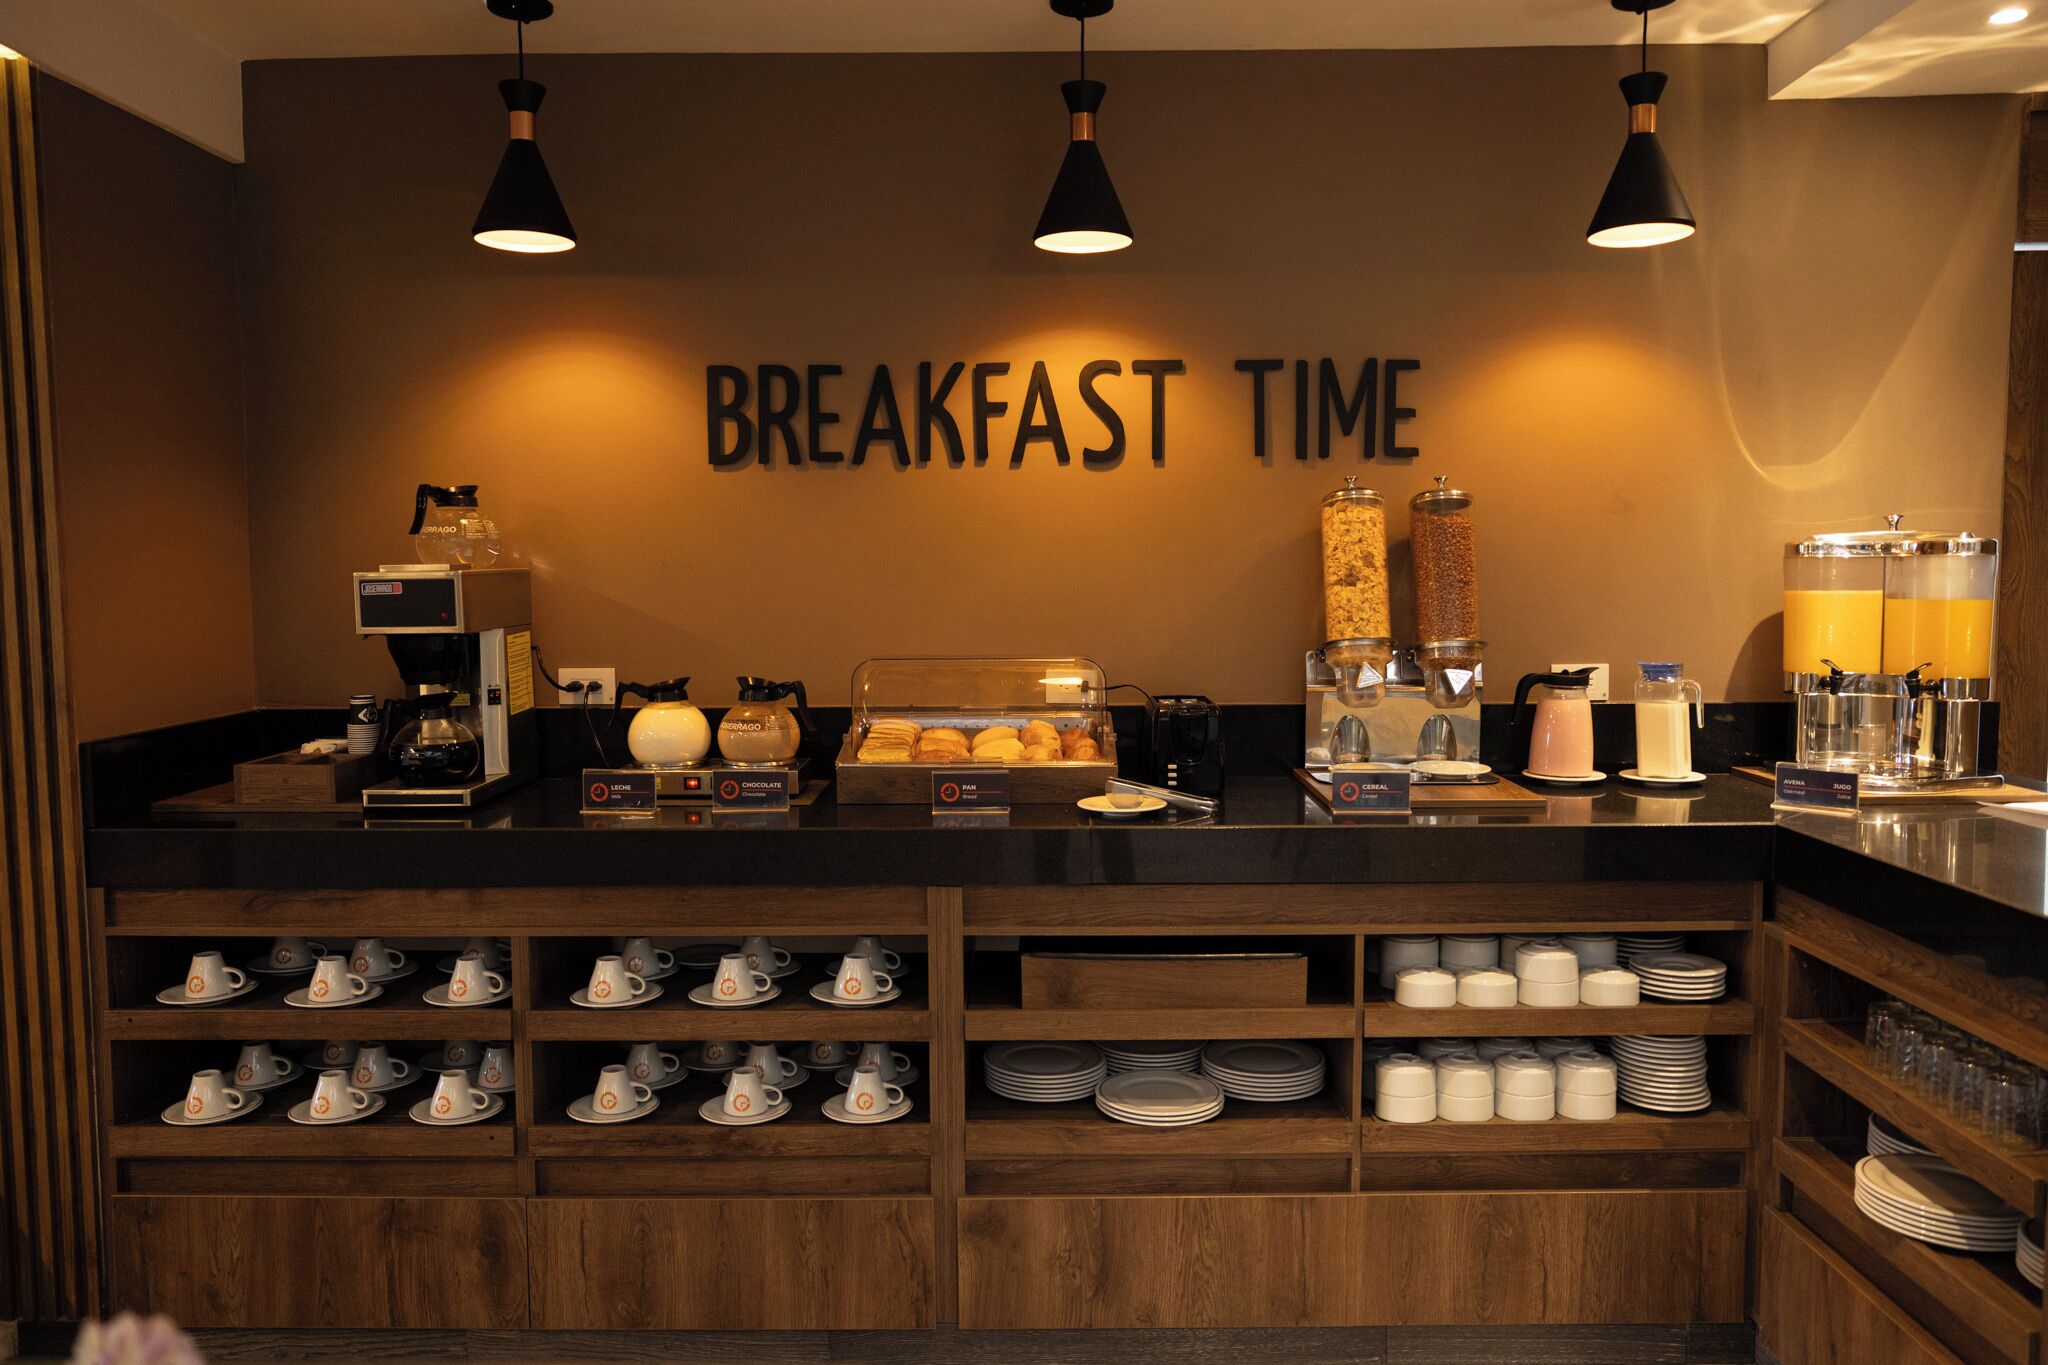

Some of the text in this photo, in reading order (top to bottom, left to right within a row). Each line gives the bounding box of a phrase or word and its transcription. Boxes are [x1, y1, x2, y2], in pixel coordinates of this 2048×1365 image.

[707, 357, 1420, 465] BREAKFAST TIME
[1783, 788, 1806, 796] Oatmeal
